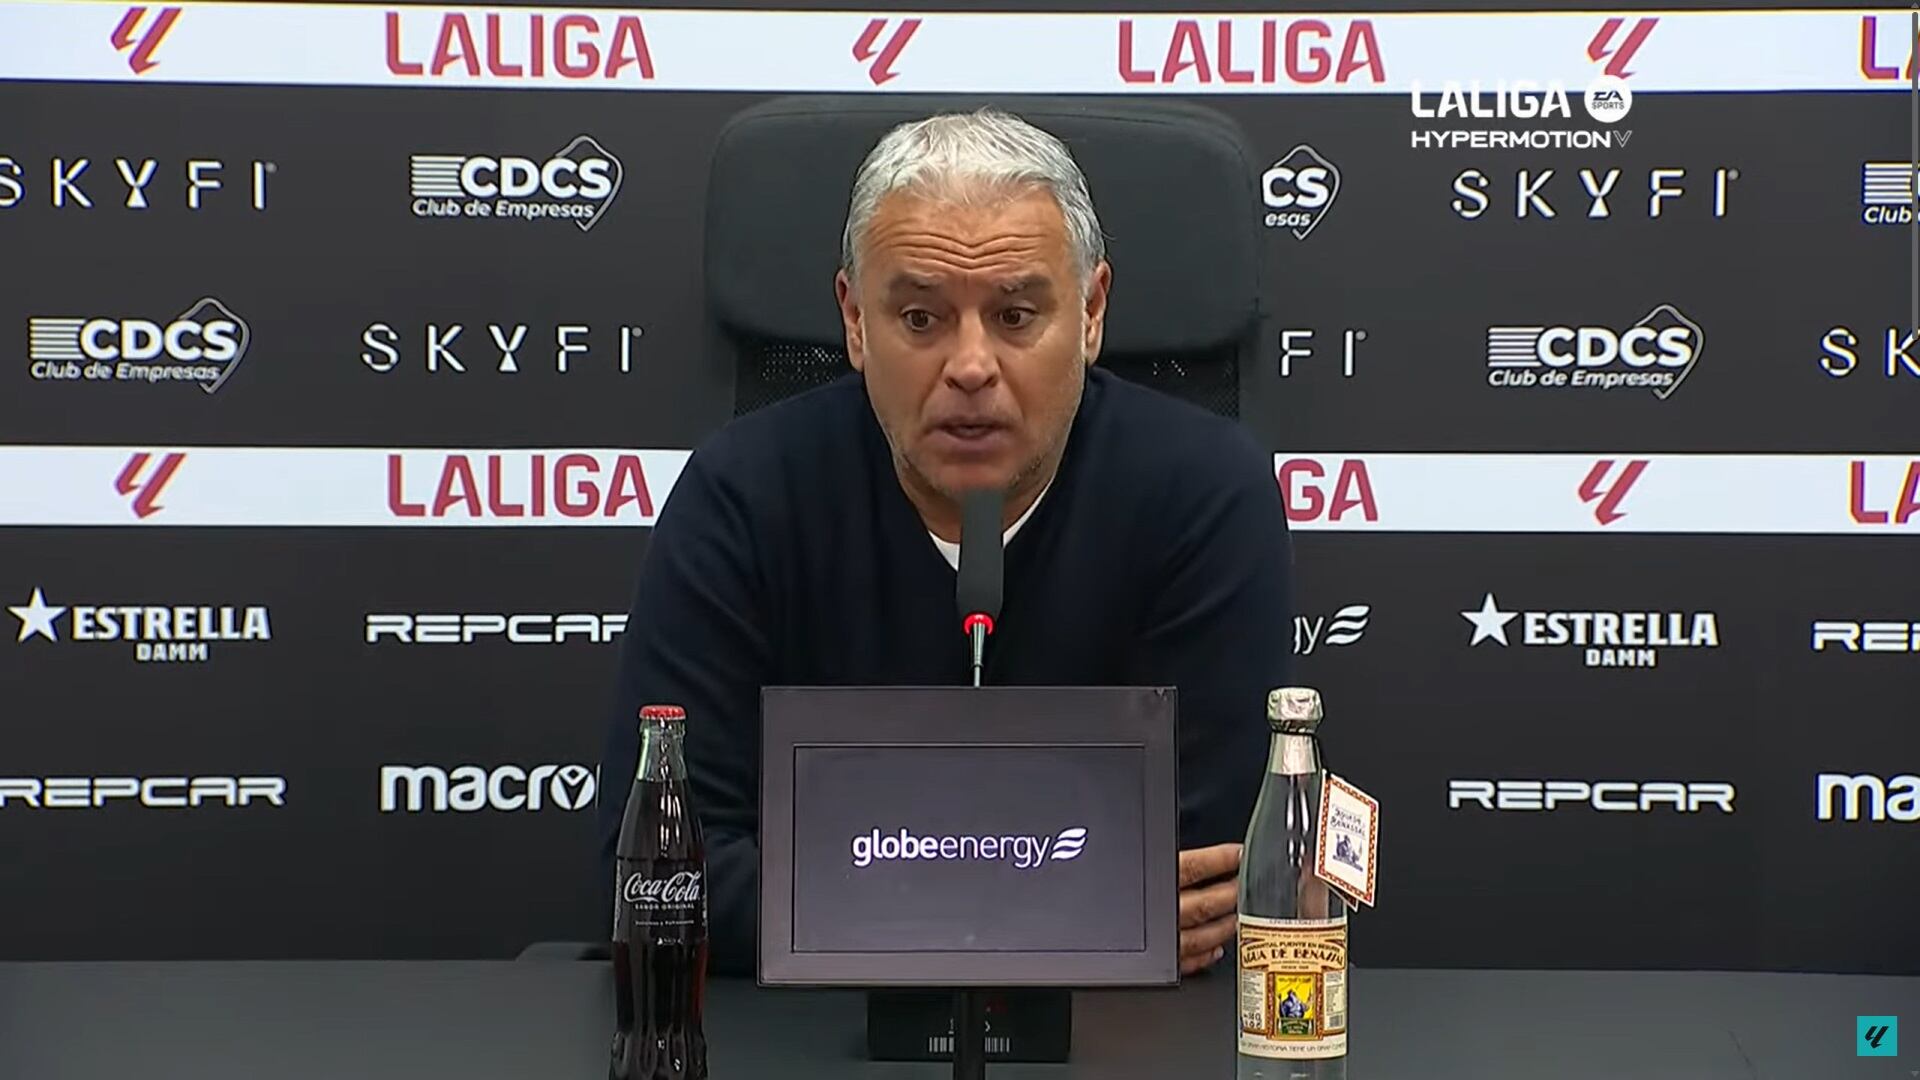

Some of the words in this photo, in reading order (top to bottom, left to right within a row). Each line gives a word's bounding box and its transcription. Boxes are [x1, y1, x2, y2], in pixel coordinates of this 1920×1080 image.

[386, 12, 654, 79] LALIGA
[1119, 20, 1385, 84] LALIGA
[1861, 16, 1920, 80] L
[460, 155, 613, 198] CDCS
[1262, 167, 1329, 208] CS
[1452, 169, 1726, 218] SKYFI
[412, 199, 461, 216] Club
[464, 199, 491, 216] de
[495, 200, 594, 220] Empresas
[1265, 213, 1311, 227] esas
[1864, 205, 1912, 223] Club
[80, 319, 237, 361] CDCS
[362, 324, 629, 372] SKYFI
[1281, 330, 1354, 376] FI
[1536, 327, 1692, 368] CDCS
[1821, 328, 1920, 376] SK
[31, 361, 81, 379] Club
[83, 361, 113, 379] de
[115, 362, 221, 382] Empresas
[1488, 370, 1537, 387] Club
[1539, 370, 1568, 387] de
[1571, 370, 1675, 389] Empresas
[389, 455, 653, 517] LALIGA
[1279, 459, 1378, 521] GA
[73, 607, 270, 639] ESTRELLA
[1523, 613, 1718, 646] ESTRELLA
[1813, 621, 1920, 651] RE
[137, 643, 208, 661] DAMM
[1585, 648, 1656, 667] DAMM
[0, 778, 286, 806] REPCAR
[380, 764, 600, 811] macro
[1449, 780, 1735, 812] REPCAR
[1817, 774, 1920, 821] ma
[852, 828, 1050, 868] globeenergy
[624, 871, 701, 902] Coca-Cola
